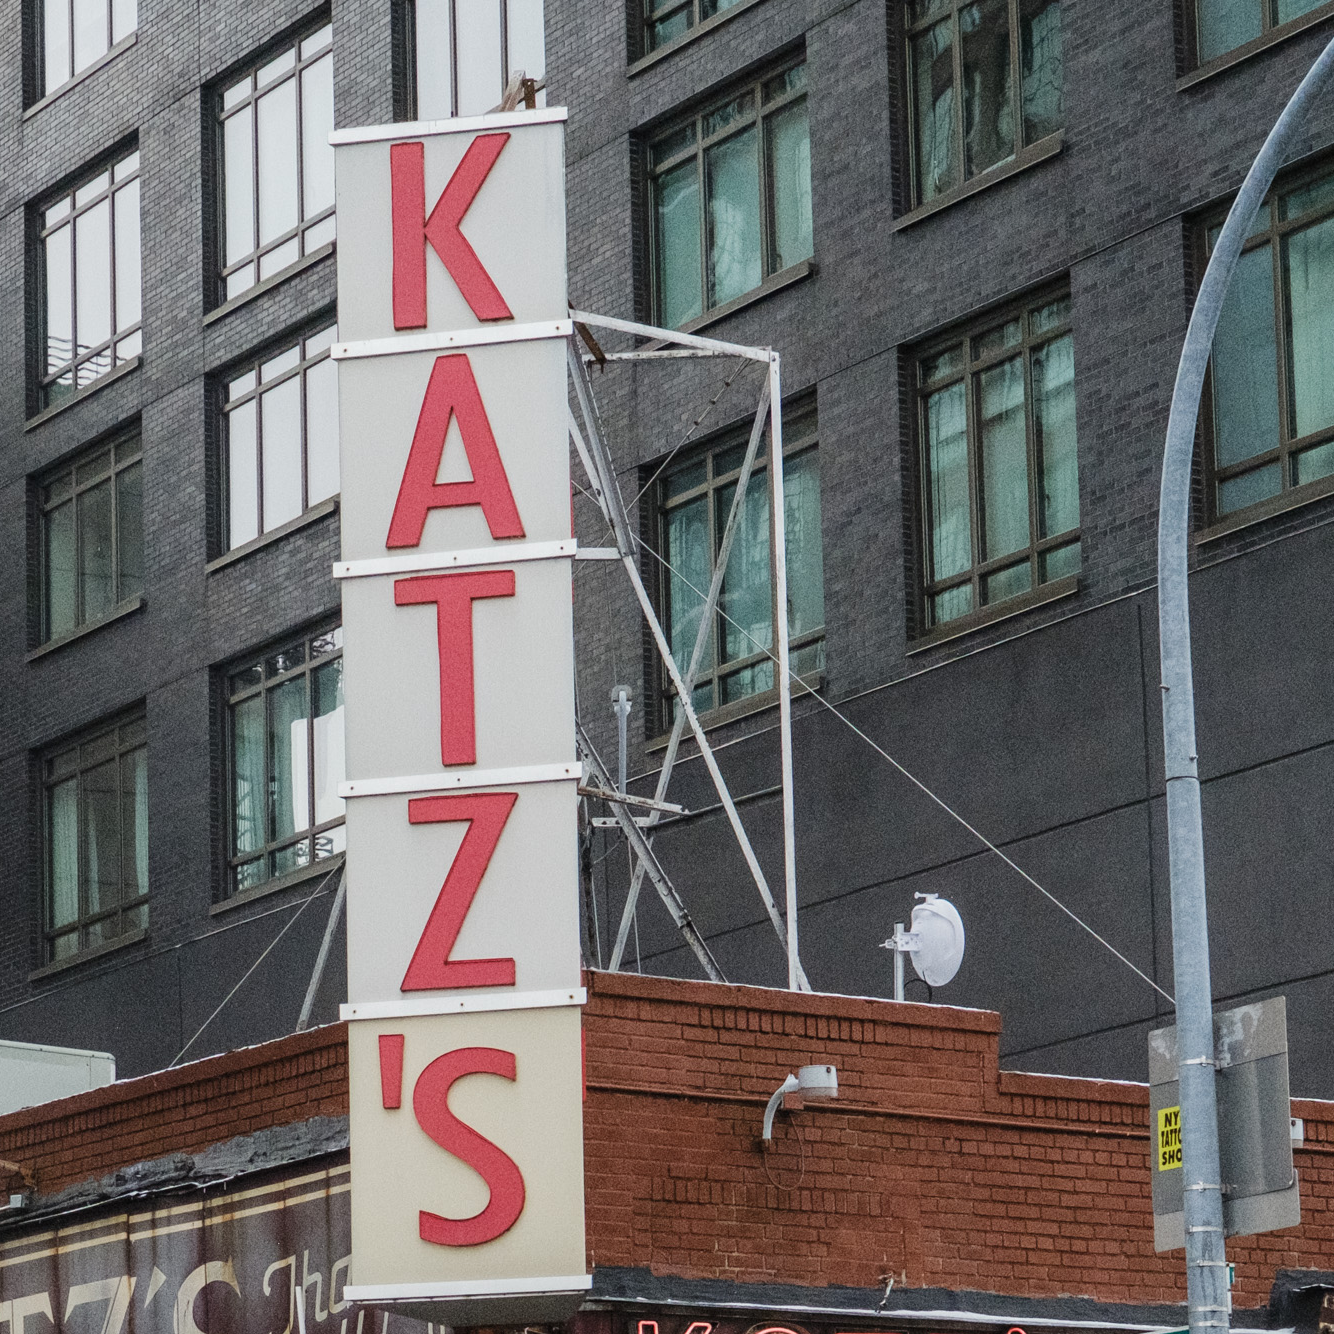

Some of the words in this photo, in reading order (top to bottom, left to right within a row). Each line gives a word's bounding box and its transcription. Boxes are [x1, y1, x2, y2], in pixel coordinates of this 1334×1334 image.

[378, 131, 527, 1247] KATZ'S
[1164, 1110, 1180, 1128] NY
[1161, 1127, 1182, 1148] TATTO
[1162, 1148, 1182, 1166] SHO
